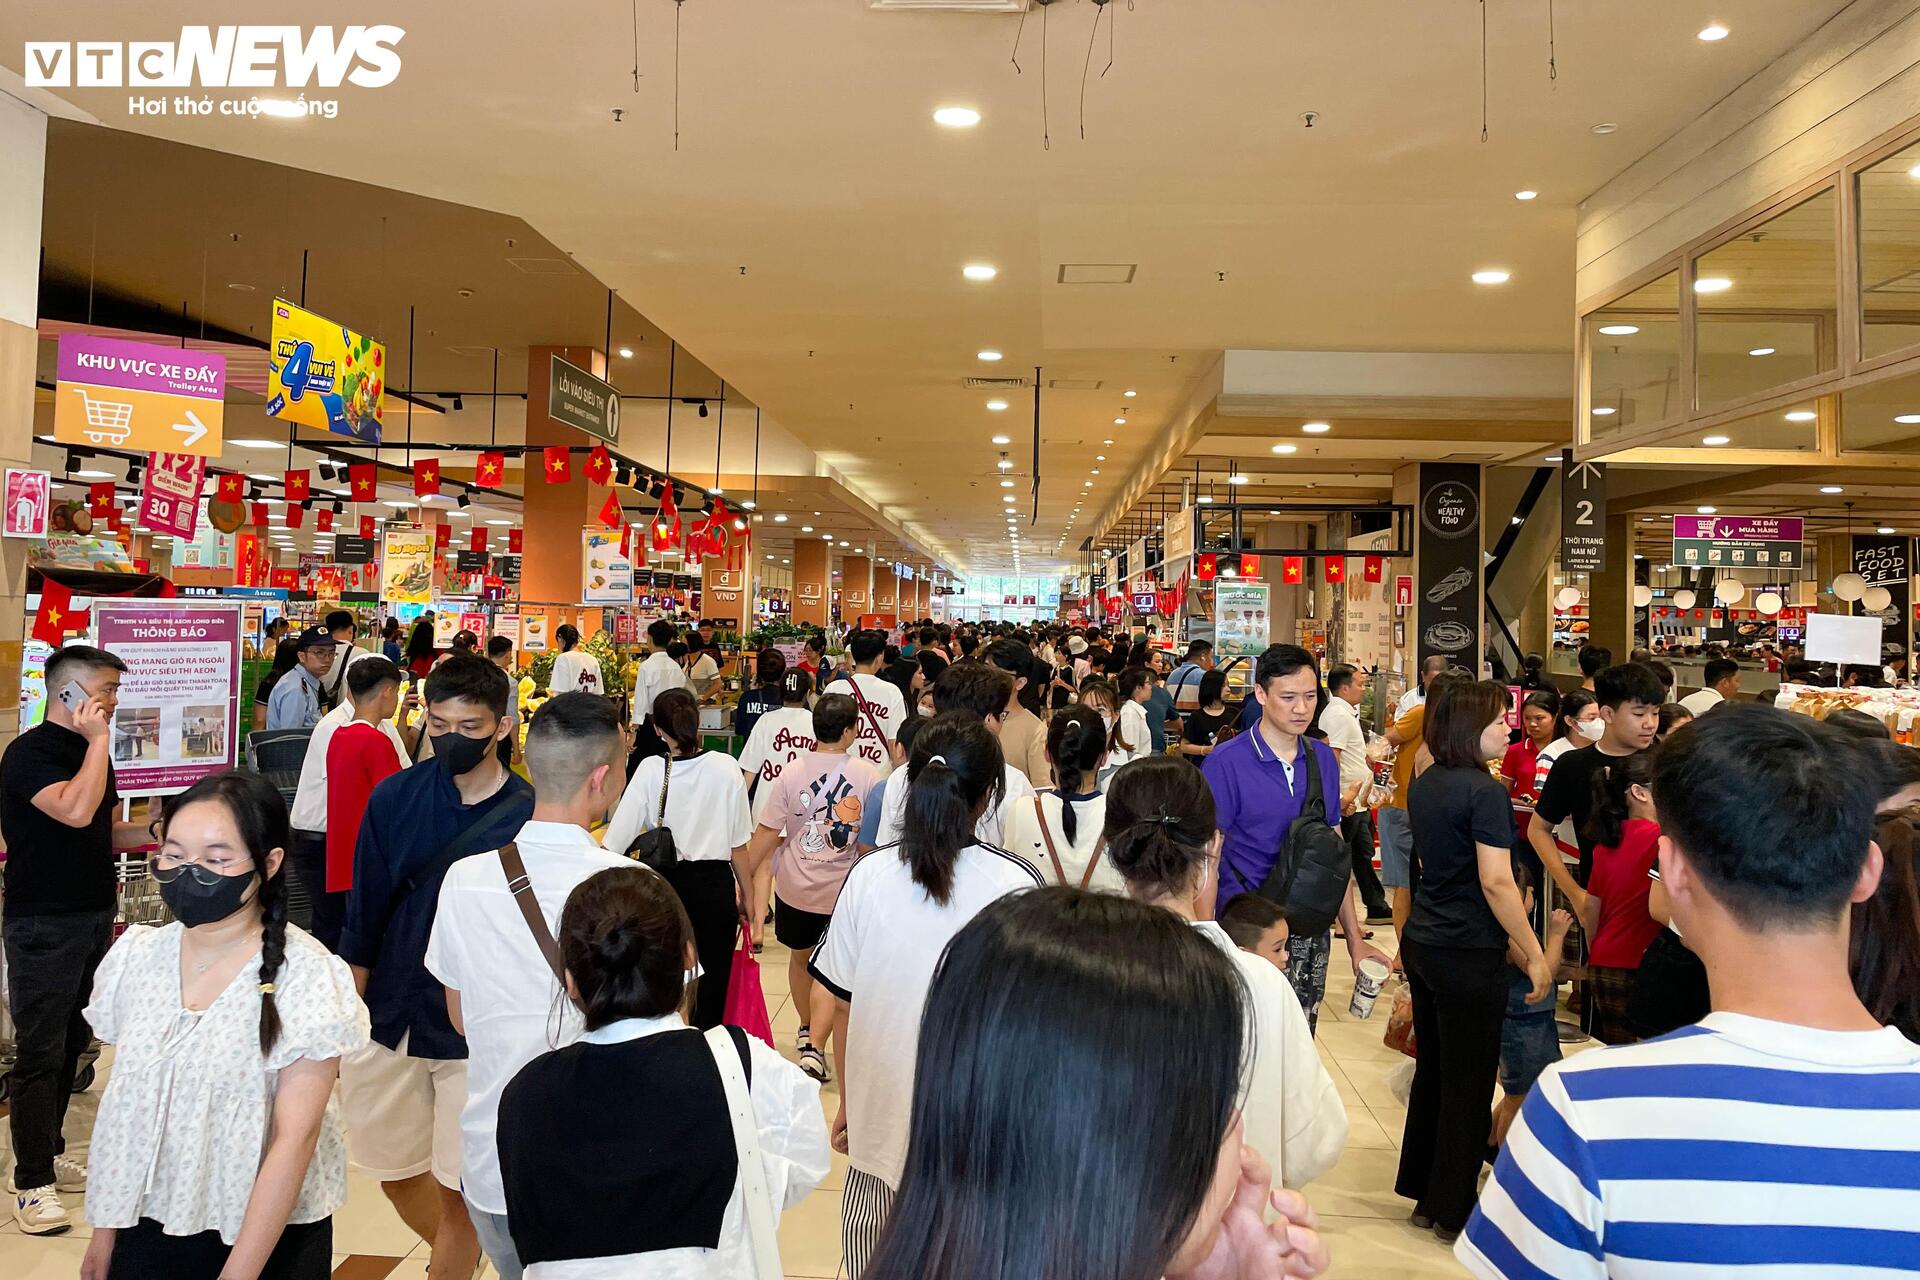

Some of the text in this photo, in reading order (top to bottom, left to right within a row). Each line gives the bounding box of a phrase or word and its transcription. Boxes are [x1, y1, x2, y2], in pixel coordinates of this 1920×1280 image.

[279, 340, 297, 357] THỨ
[77, 352, 218, 384] KHU VỰC XE ĐẨY
[282, 342, 314, 401] 4
[309, 361, 323, 375] VUI
[323, 360, 335, 377] VẺ
[168, 380, 218, 394] Trolley Area
[560, 371, 569, 394] LỐI
[570, 380, 583, 400] VÀO
[583, 388, 596, 406] SIÊU
[150, 498, 169, 518] 30
[1575, 500, 1593, 525] 2
[1441, 516, 1459, 525] FOOD
[1757, 526, 1778, 534] HÀNG
[1565, 535, 1604, 545] THỜI TRANG
[1587, 547, 1596, 555] NỮ
[1855, 545, 1900, 560] FAST
[1858, 557, 1904, 571] FOOD
[1862, 567, 1904, 582] SET
[490, 589, 496, 600] 1
[1137, 583, 1150, 592] 32
[642, 596, 648, 606] 6
[664, 598, 670, 606] 7
[715, 592, 737, 601] VND
[772, 601, 779, 609] 8
[132, 625, 207, 638] THÔNG BÁO
[199, 656, 225, 664] NGOÀI
[159, 667, 177, 675] SIÊU
[179, 667, 192, 675] THỊ
[855, 716, 876, 740] la
[858, 741, 882, 764] vie
[763, 759, 783, 782] de
